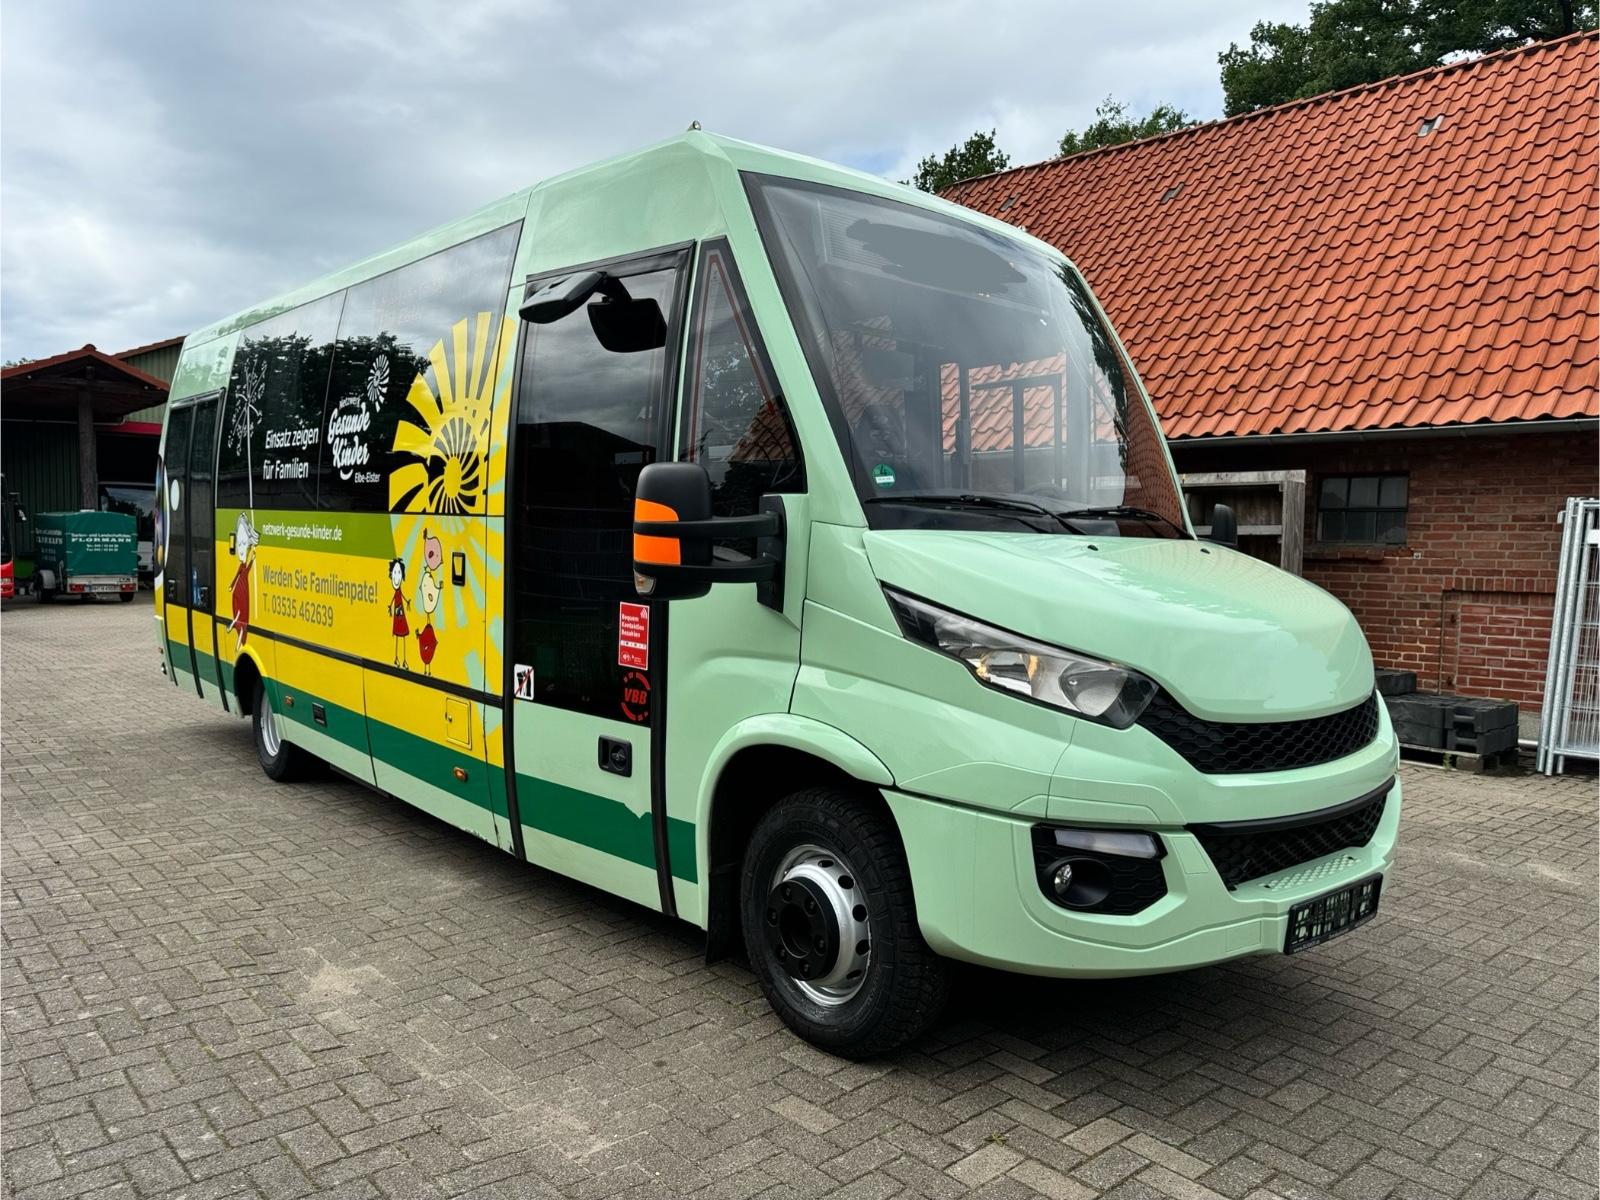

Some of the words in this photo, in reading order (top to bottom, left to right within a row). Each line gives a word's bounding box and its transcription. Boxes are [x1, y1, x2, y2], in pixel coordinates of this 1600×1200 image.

[327, 401, 371, 444] Gesunde
[265, 428, 291, 449] Einsatz
[292, 427, 319, 450] zeigen
[332, 435, 370, 468] Kinder
[263, 459, 274, 480] für
[275, 457, 309, 479] Familien
[354, 472, 381, 483] Elbe-Elster
[262, 522, 342, 541] netzwerk-gesunde-kinder.de
[262, 564, 292, 589] Werden
[294, 569, 307, 591] Sie
[310, 571, 378, 605] Familienpate!
[262, 592, 270, 613] T.
[272, 594, 297, 619] 03535
[299, 600, 334, 628] 462639
[624, 687, 648, 705] VBB
